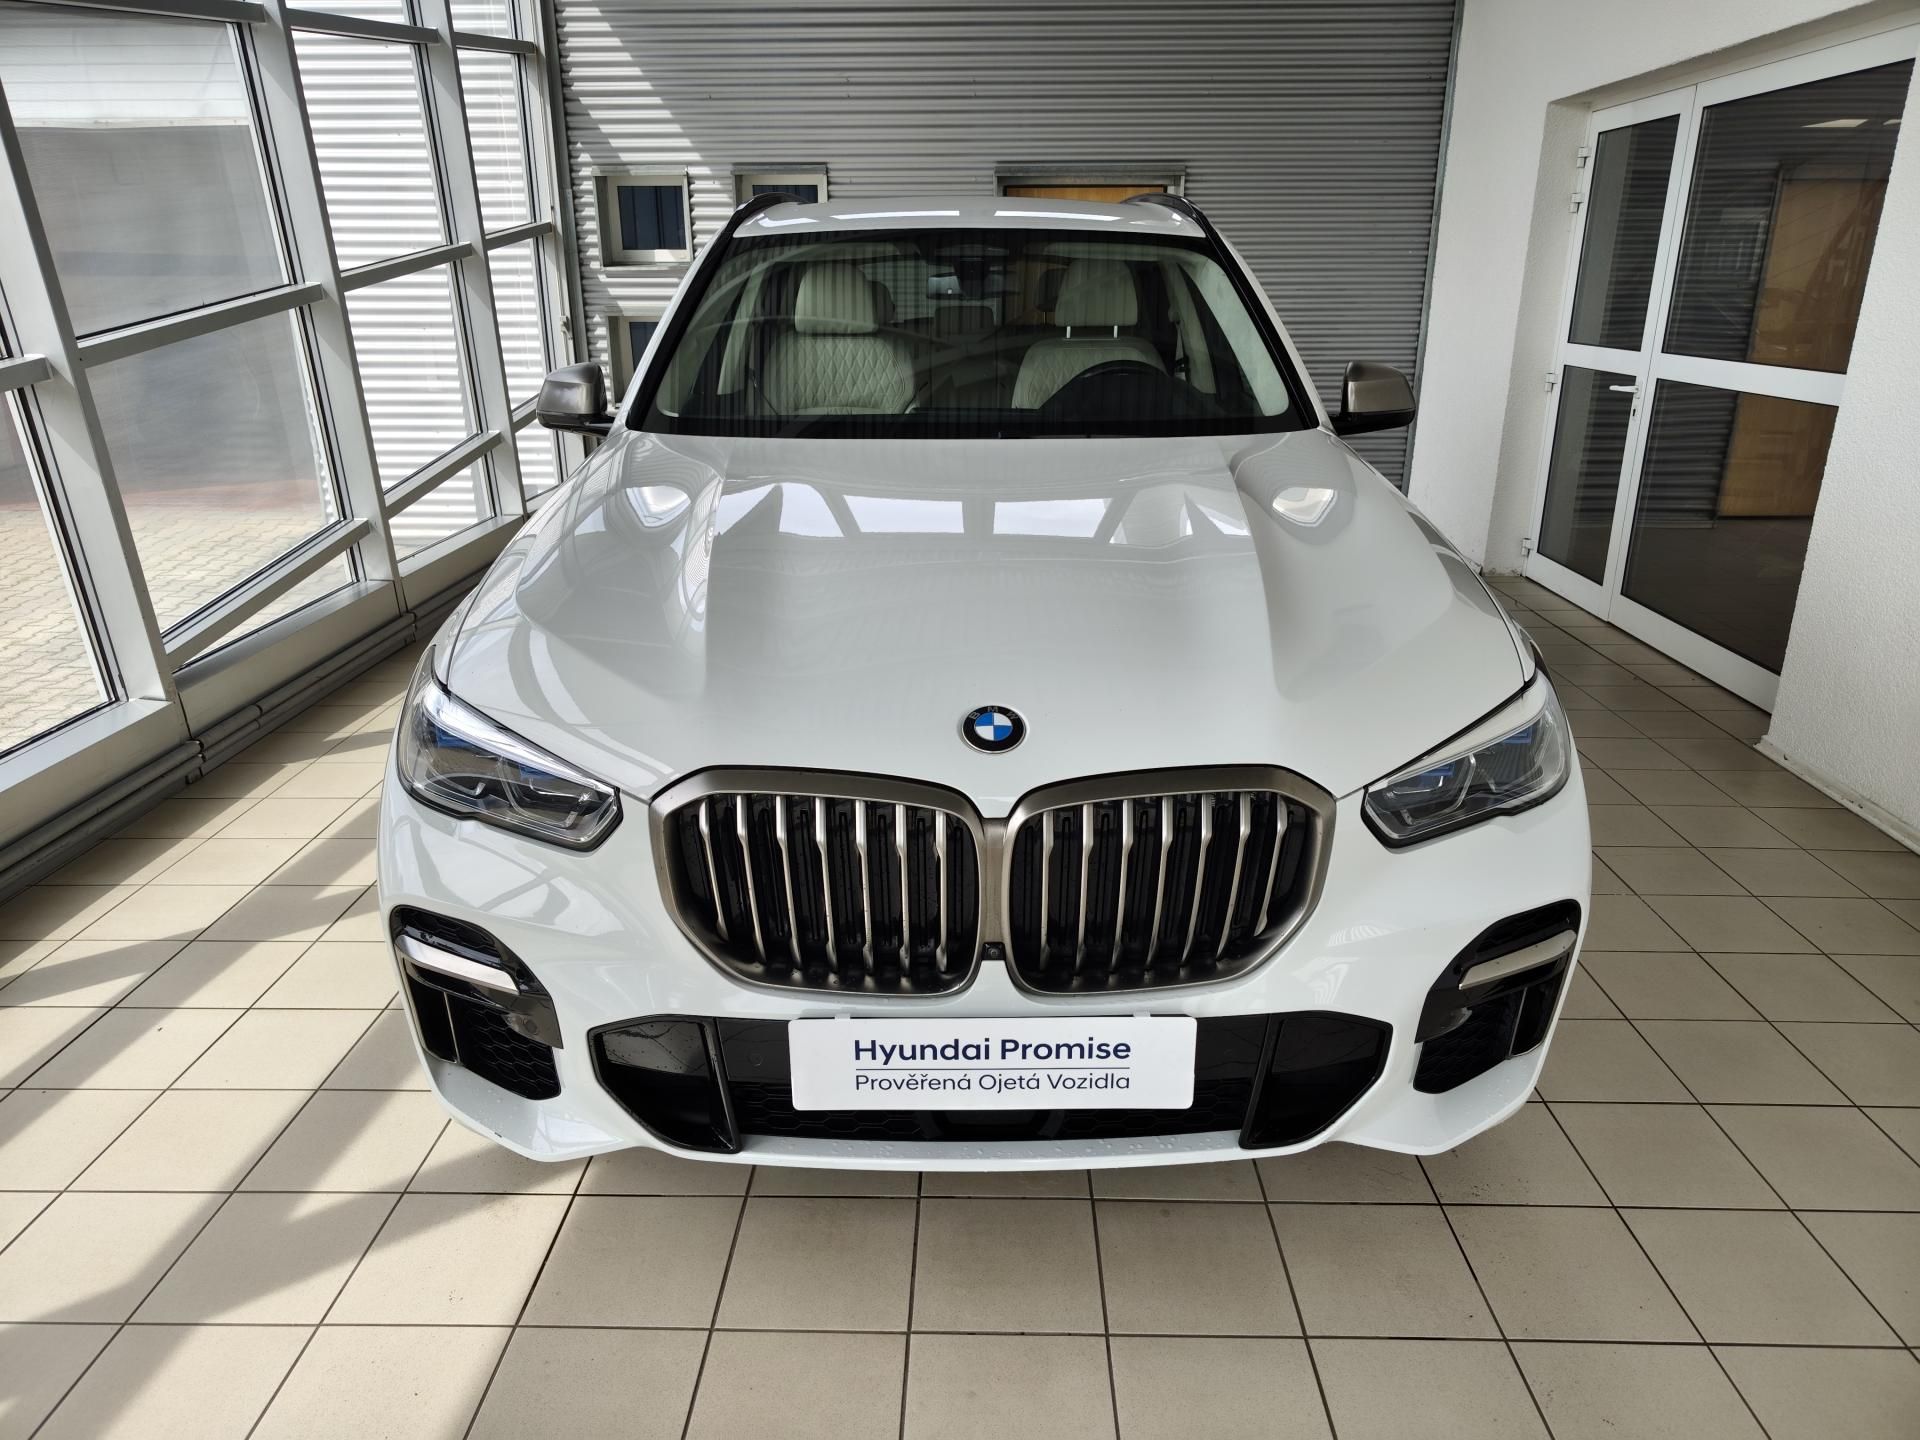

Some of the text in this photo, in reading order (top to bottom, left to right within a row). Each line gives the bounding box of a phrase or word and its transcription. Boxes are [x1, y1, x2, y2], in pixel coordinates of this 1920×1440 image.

[969, 706, 1019, 720] BMW
[854, 1037, 1131, 1065] Hyundai Promise
[855, 1072, 1130, 1094] Prověřená Ojetá Vozidla
